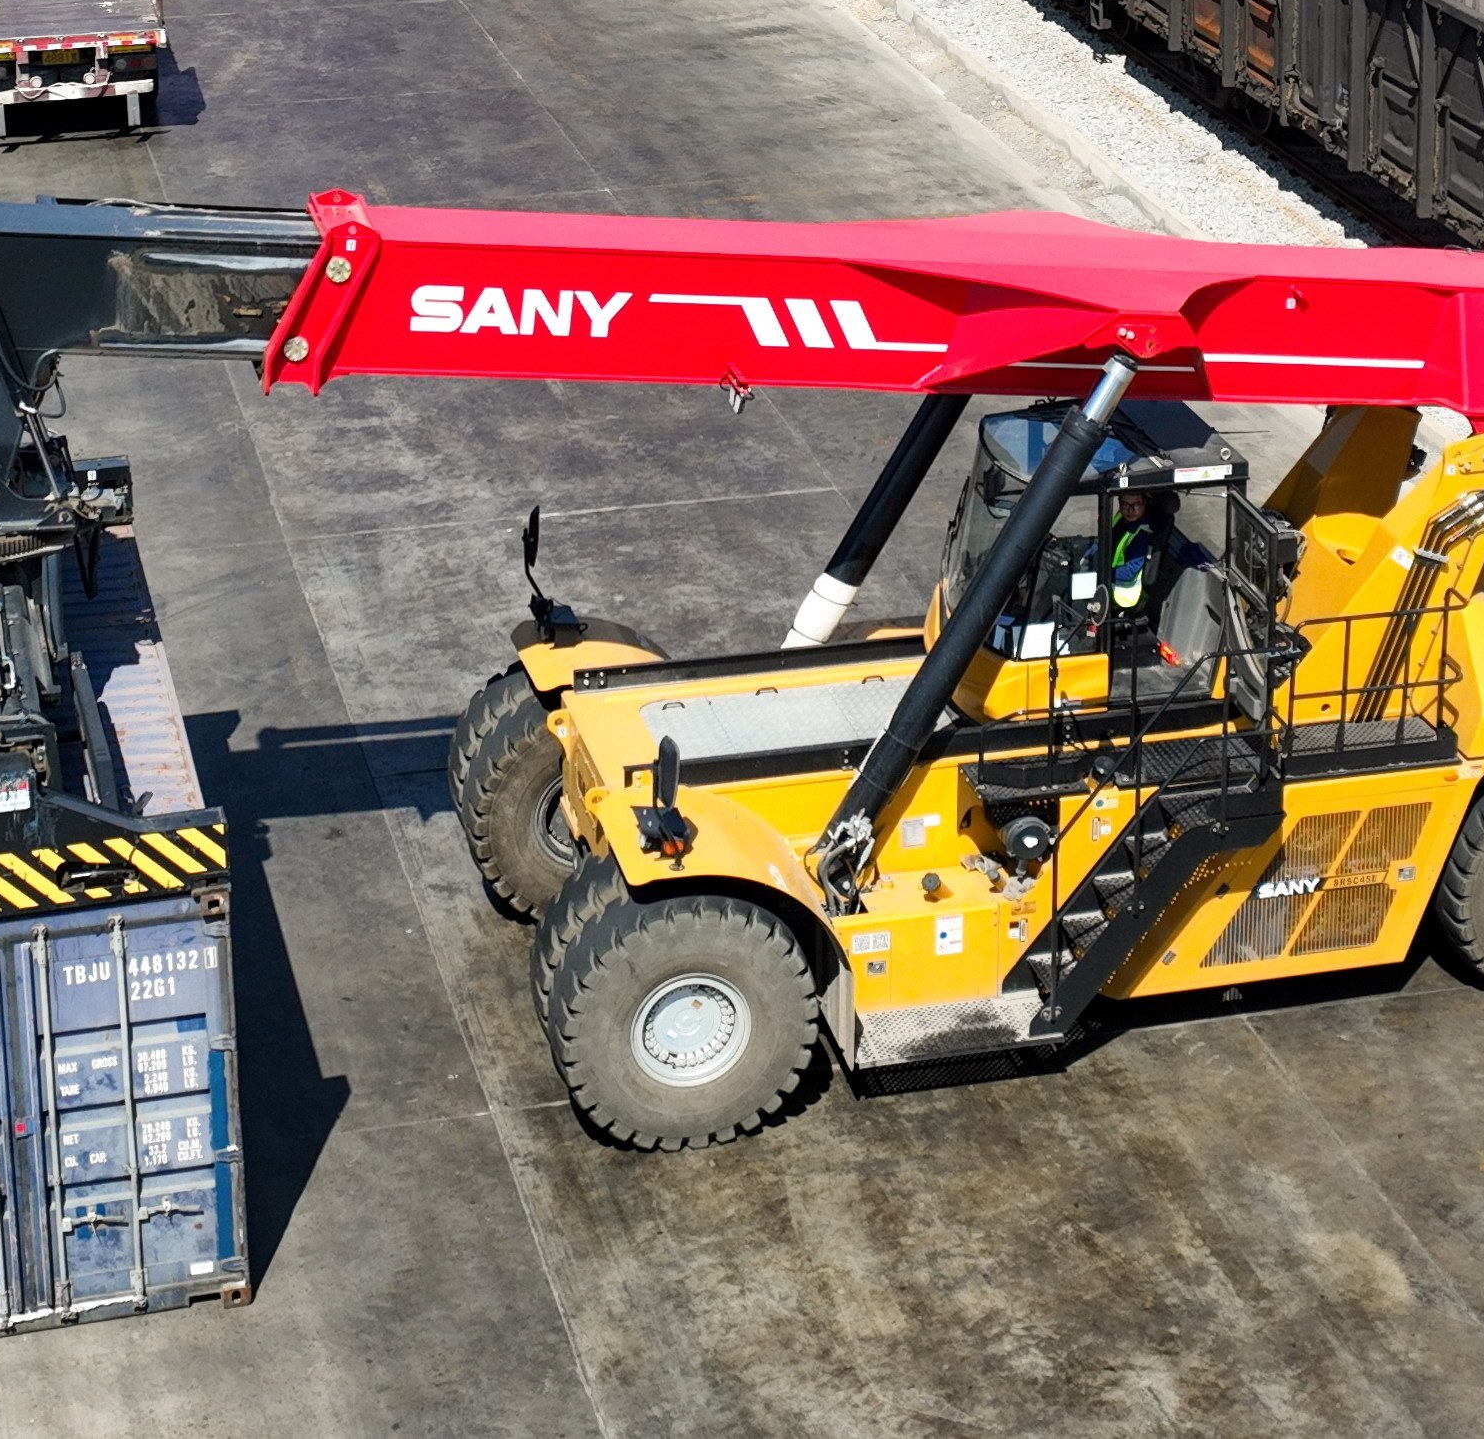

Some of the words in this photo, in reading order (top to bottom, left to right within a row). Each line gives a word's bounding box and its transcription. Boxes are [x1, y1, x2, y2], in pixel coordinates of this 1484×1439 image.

[409, 284, 633, 338] SANY
[1258, 878, 1320, 899] SANY
[63, 961, 112, 986] TBJU
[128, 953, 200, 977] 448132
[204, 946, 218, 969] 1
[130, 977, 177, 1002] 22G1
[57, 1062, 78, 1075] MAX
[91, 1056, 118, 1070] GROSS
[181, 1045, 197, 1056] KG.
[59, 1084, 80, 1097] TARE
[183, 1067, 198, 1078] KG.
[63, 1133, 79, 1146] NET
[186, 1117, 201, 1128] KG.
[144, 1154, 168, 1167] 1.170
[148, 1144, 167, 1156] 33.2
